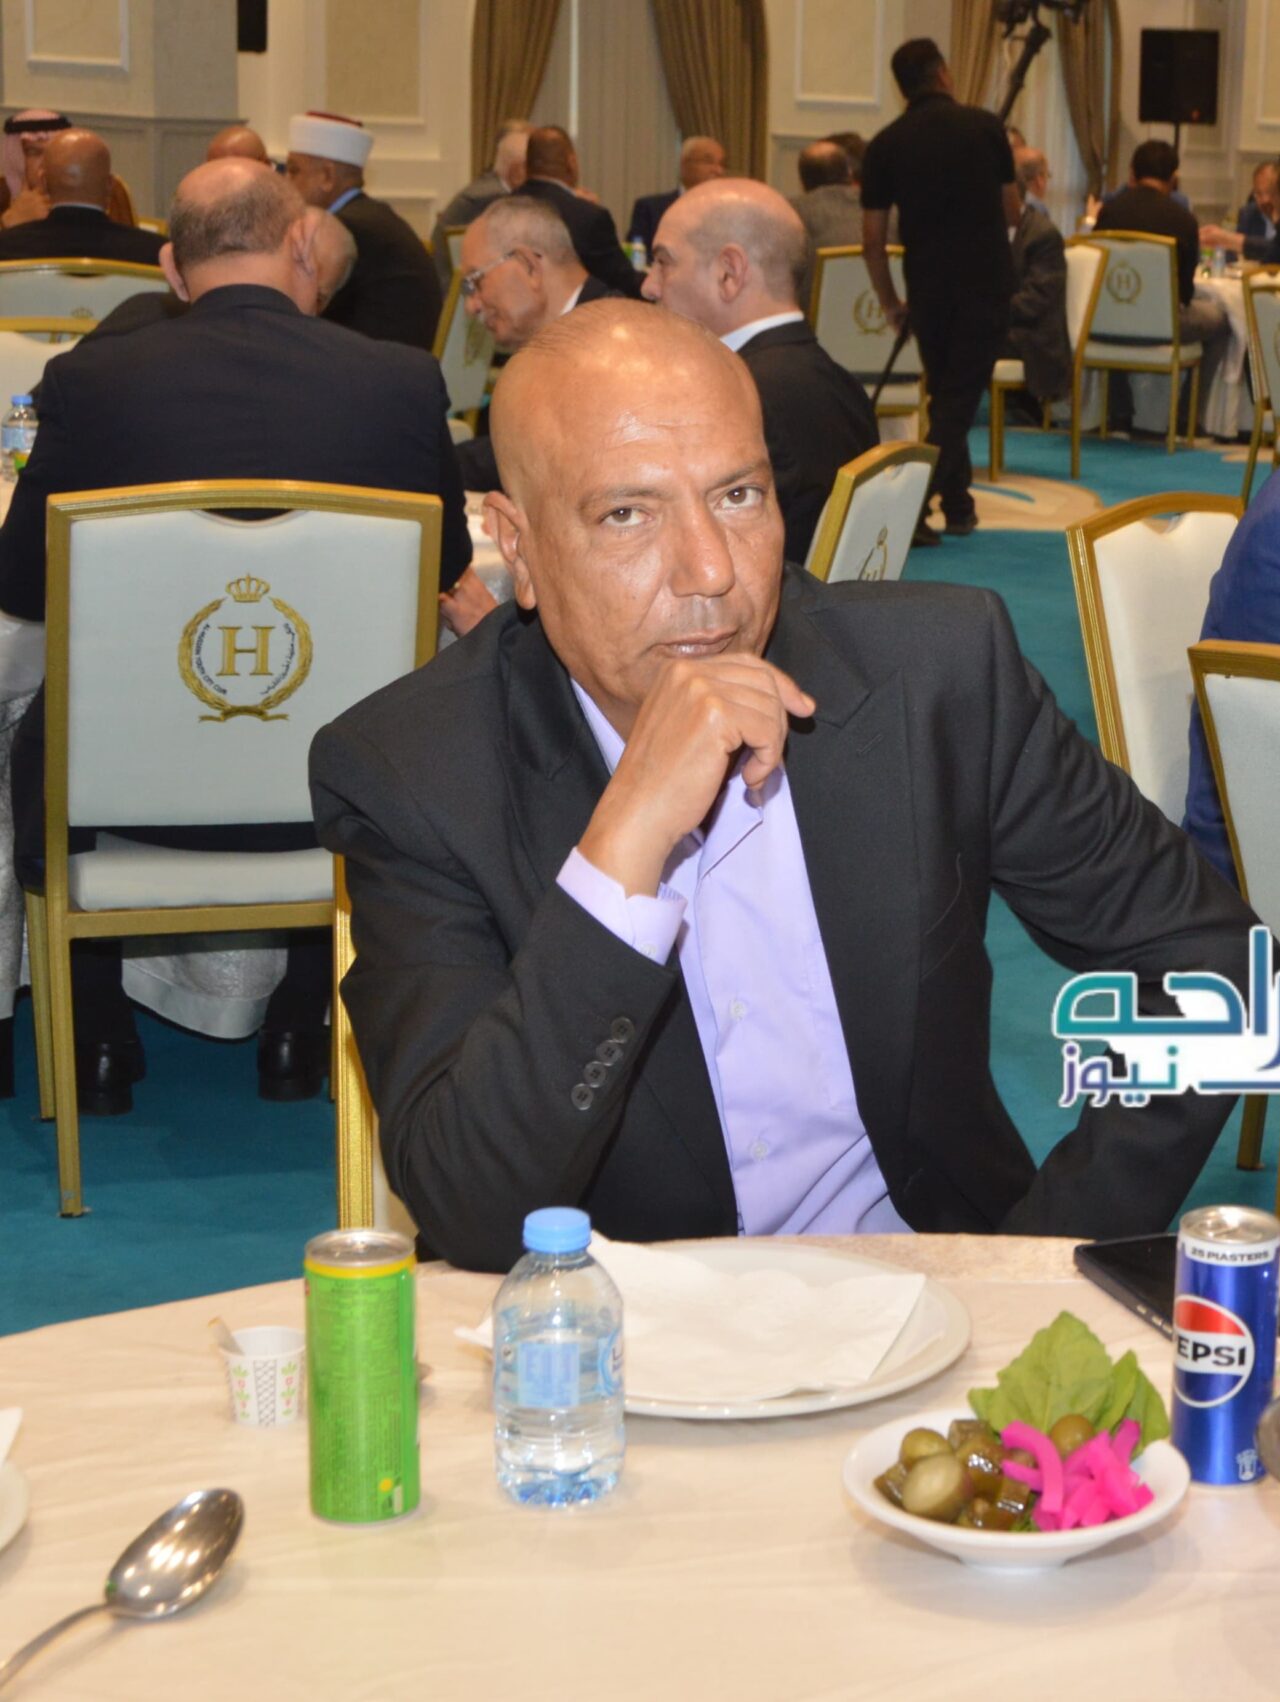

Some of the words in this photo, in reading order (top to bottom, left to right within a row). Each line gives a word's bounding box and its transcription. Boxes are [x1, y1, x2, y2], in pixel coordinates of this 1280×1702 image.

[215, 625, 276, 677] H
[1191, 1246, 1204, 1257] 25
[1207, 1250, 1269, 1262] PIASTERS
[1177, 1336, 1246, 1367] EPSI
